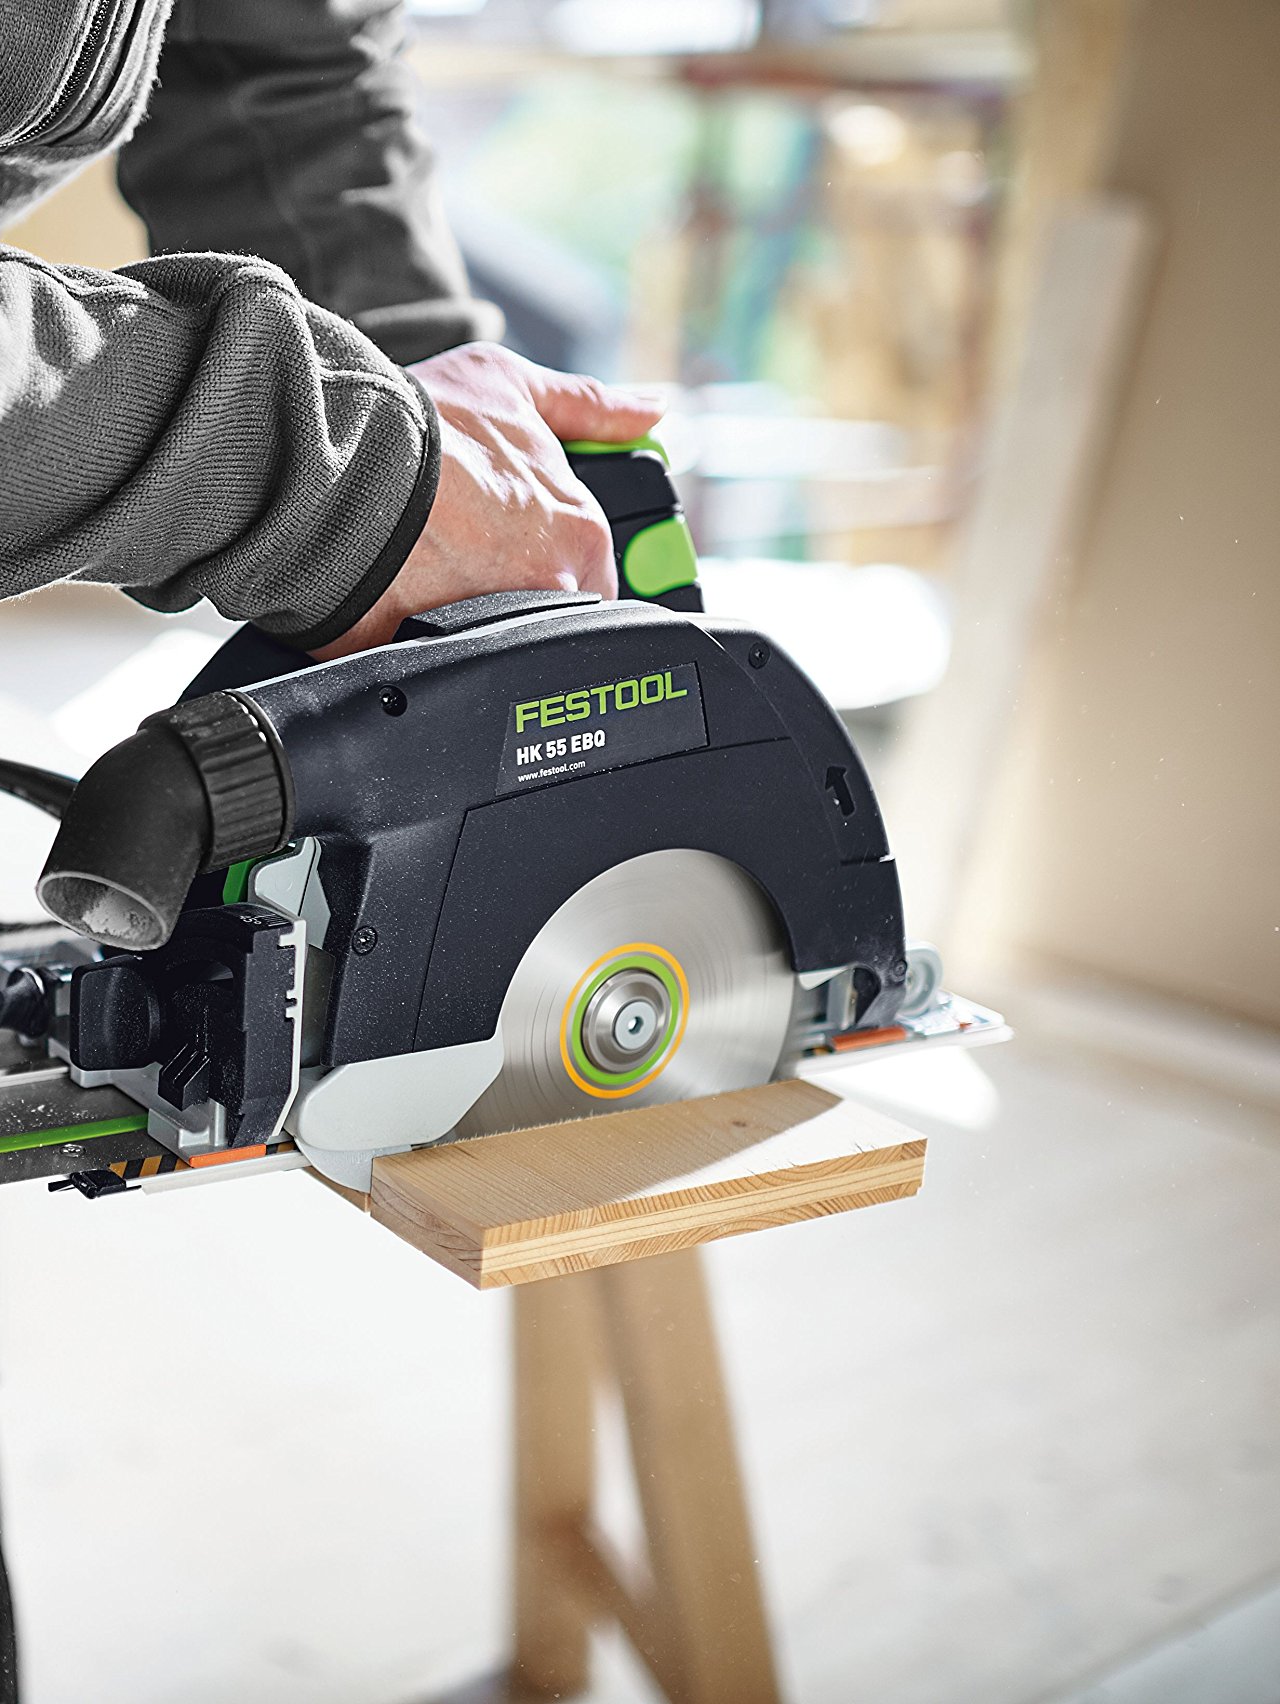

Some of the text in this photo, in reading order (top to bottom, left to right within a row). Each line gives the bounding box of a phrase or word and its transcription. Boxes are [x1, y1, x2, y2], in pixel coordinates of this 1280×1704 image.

[515, 671, 688, 733] FESTOOL
[516, 729, 606, 766] HK 55 EBQ
[517, 760, 586, 783] www.festool.com
